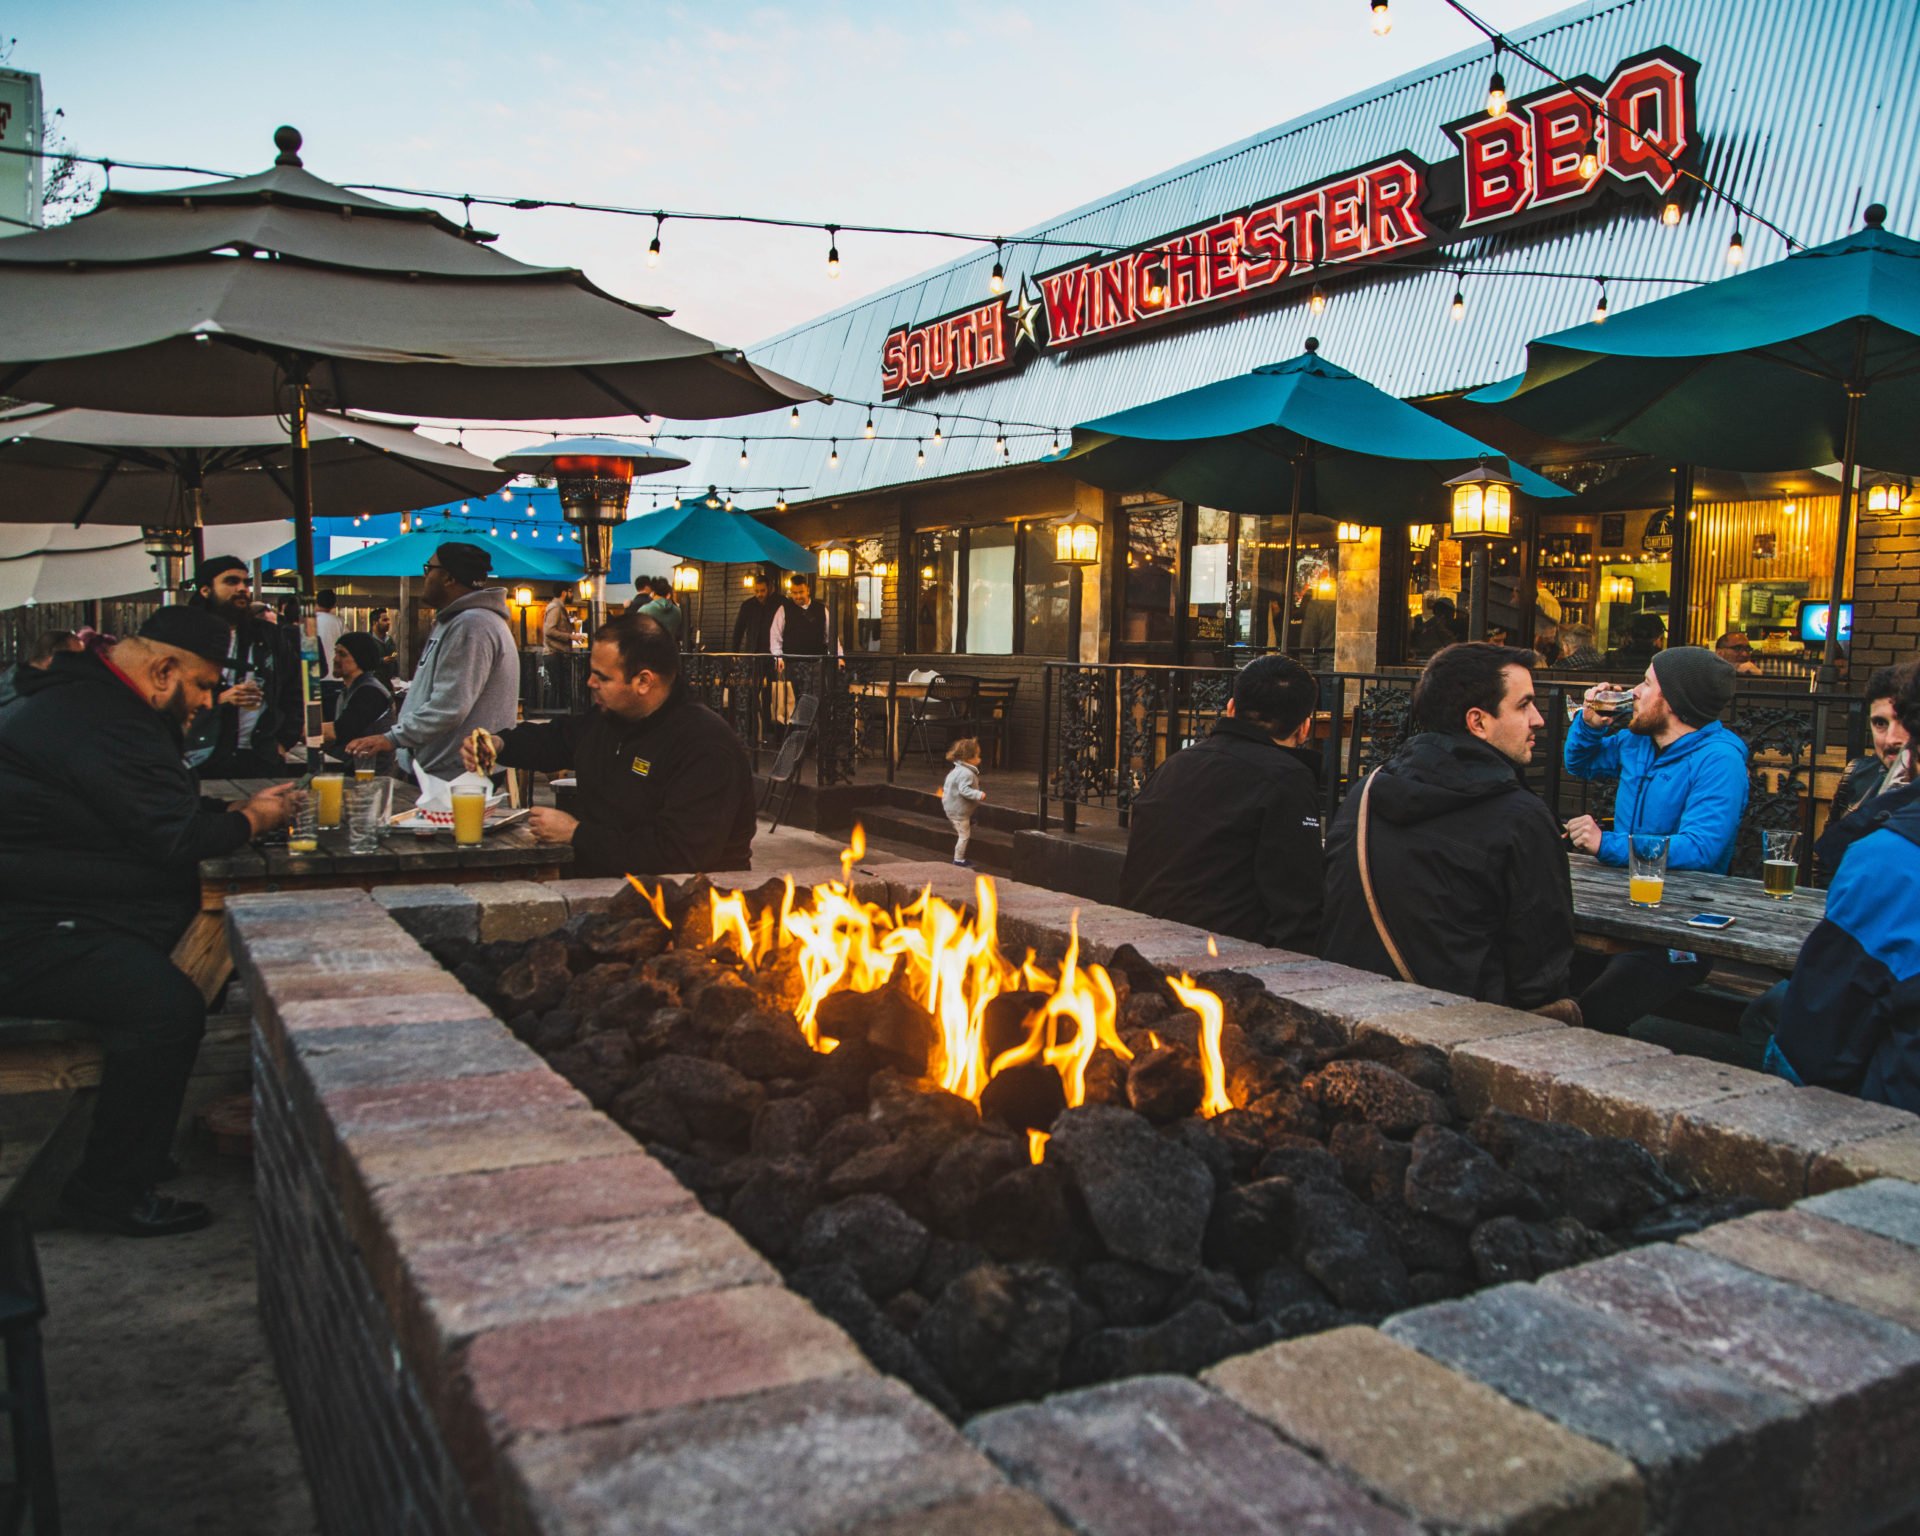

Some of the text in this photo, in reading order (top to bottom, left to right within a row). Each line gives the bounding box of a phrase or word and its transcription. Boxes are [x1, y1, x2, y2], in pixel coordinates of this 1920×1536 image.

[882, 58, 1688, 393] SOUTH WINCHESTER BBQ
